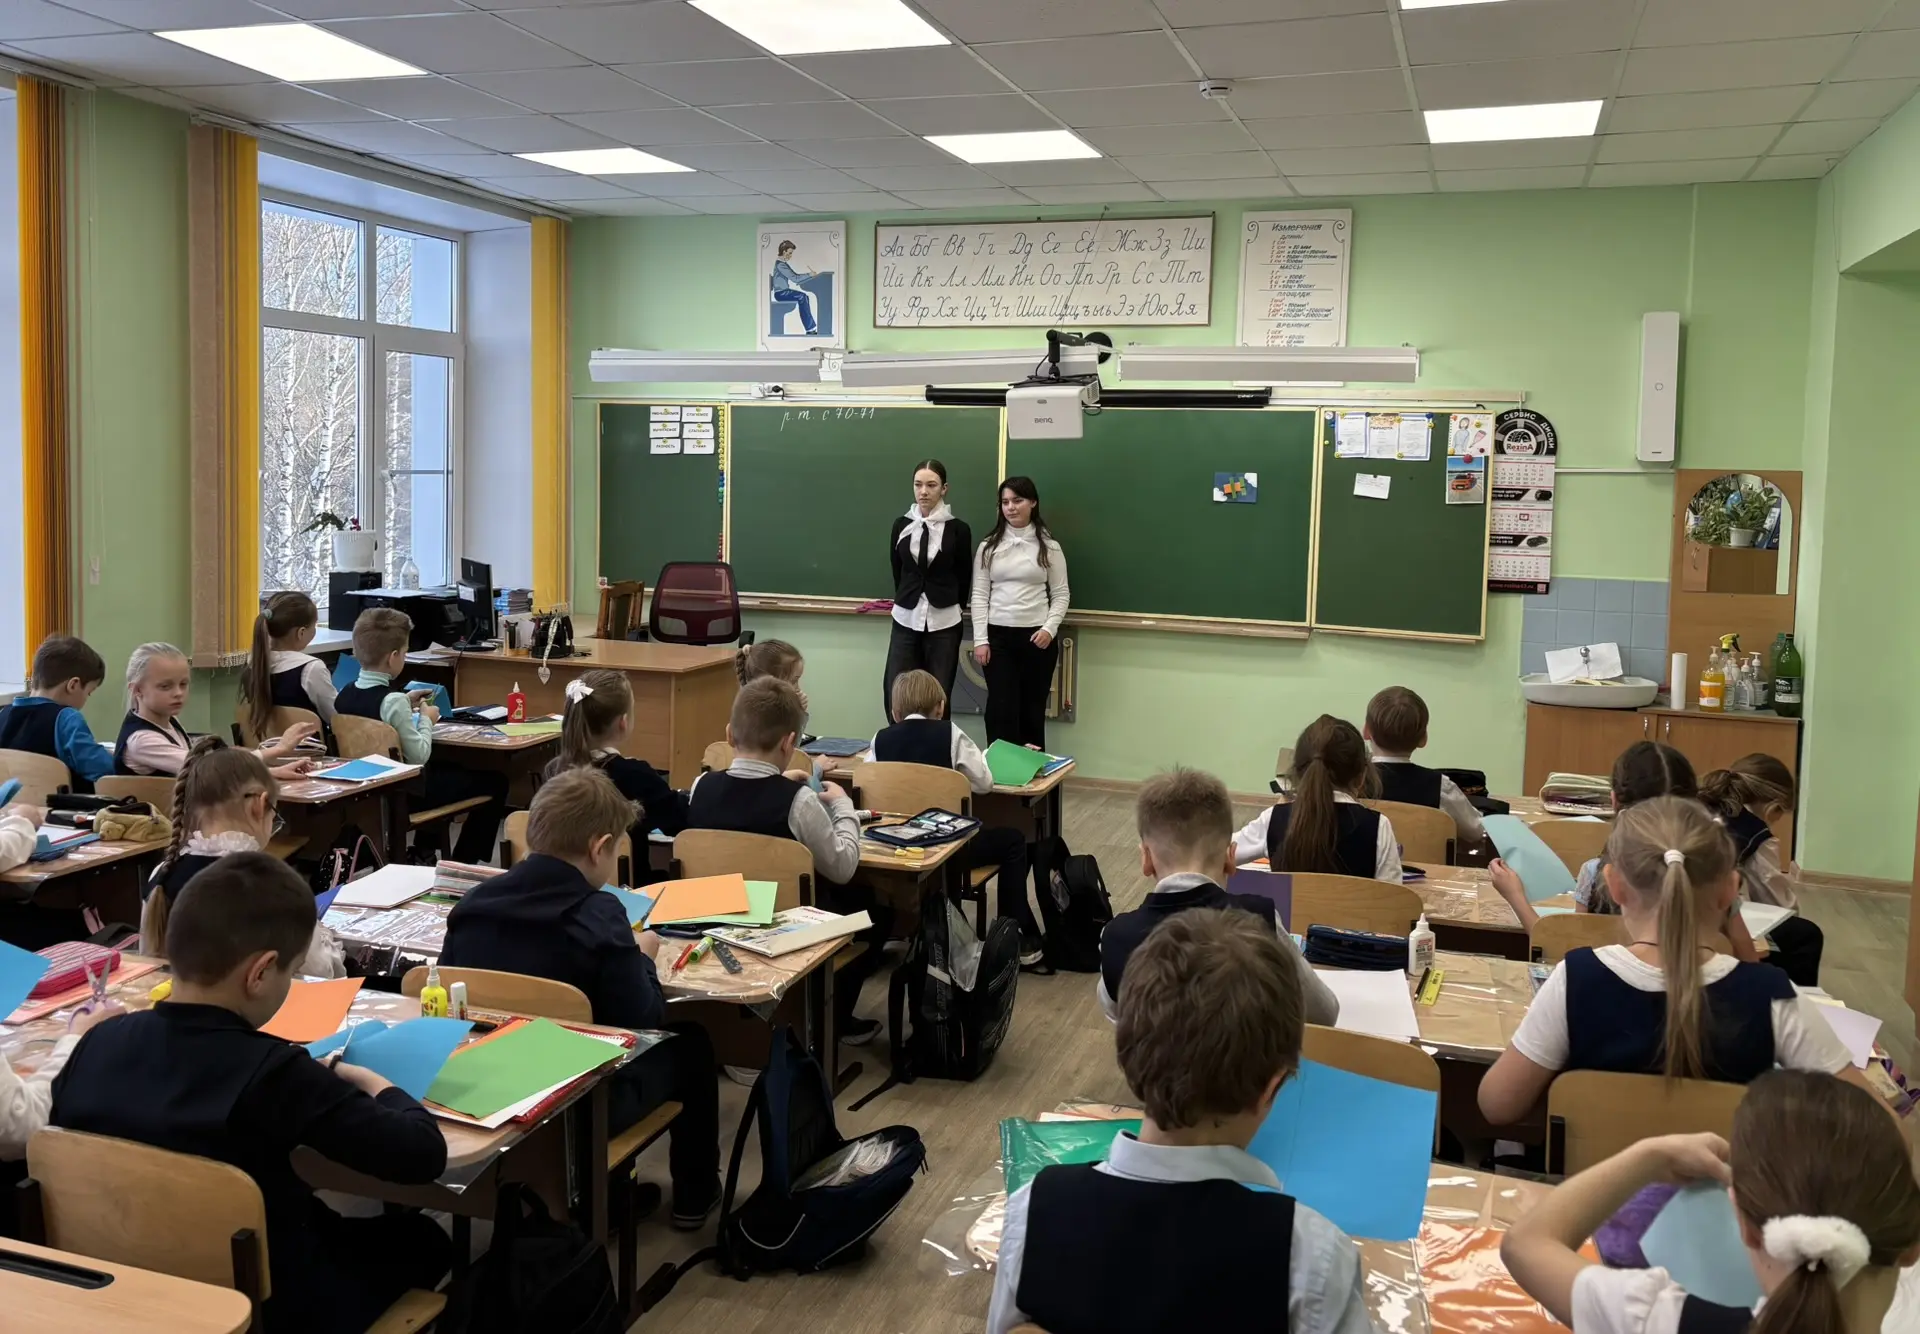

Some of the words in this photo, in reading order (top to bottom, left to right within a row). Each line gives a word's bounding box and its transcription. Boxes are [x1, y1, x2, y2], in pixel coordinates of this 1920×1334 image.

[1271, 223, 1323, 232] Измерения
[881, 235, 904, 257] Аа
[910, 235, 940, 257] Бб
[943, 234, 965, 256] Вв
[973, 233, 996, 256] Гг
[1008, 232, 1034, 264] Дд
[1041, 232, 1061, 254] Ее
[1108, 229, 1149, 252] Жж
[1150, 228, 1171, 260] Зз
[1181, 227, 1205, 250] Ии
[883, 263, 905, 288] Йй
[911, 266, 934, 288] Кк
[940, 265, 967, 288] Лл
[972, 265, 1006, 287] Мм
[1009, 264, 1036, 287] Нн
[1040, 264, 1061, 286] Оо
[1065, 262, 1095, 285] Пп
[1097, 261, 1121, 295] Рр
[1132, 261, 1154, 285] Сс
[1160, 260, 1205, 284] Тт
[878, 296, 898, 326] Уу
[902, 296, 929, 325] Фф
[931, 296, 959, 318] Хх
[963, 296, 987, 321] Цц
[990, 295, 1010, 319] Чч
[1016, 295, 1047, 318] Шш
[1113, 294, 1136, 316] Ээ
[1138, 293, 1169, 316] Юю
[1170, 292, 1198, 316] Яя
[1503, 411, 1537, 421] СЕРВИС
[1506, 443, 1534, 451] RezinA
[1540, 422, 1555, 449] ДИСКИ
